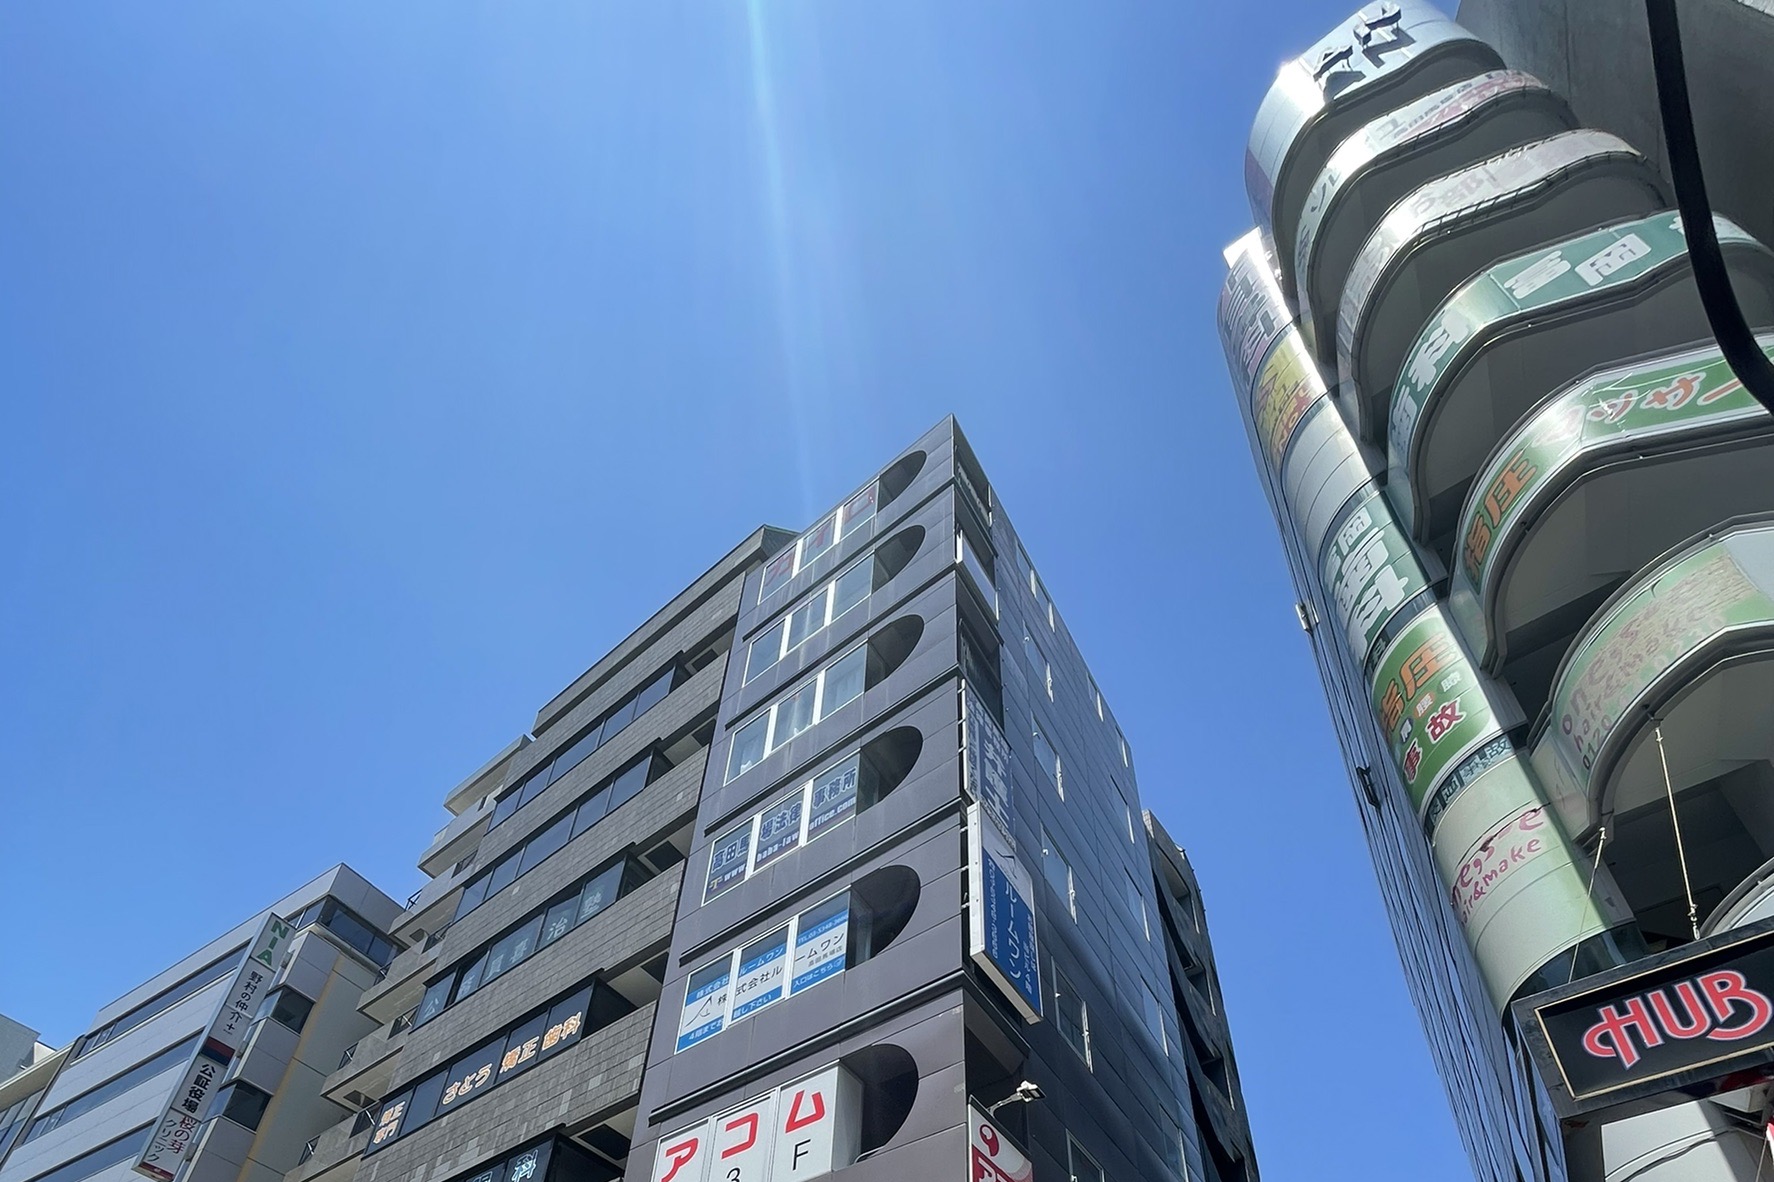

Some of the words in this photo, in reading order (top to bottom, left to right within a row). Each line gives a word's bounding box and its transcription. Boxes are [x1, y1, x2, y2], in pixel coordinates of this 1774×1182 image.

[257, 920, 289, 966] NIA
[1005, 881, 1022, 980] ルームワン
[1581, 969, 1773, 1070] HUB
[442, 1063, 493, 1105] さとう
[147, 1118, 177, 1162] クリニック
